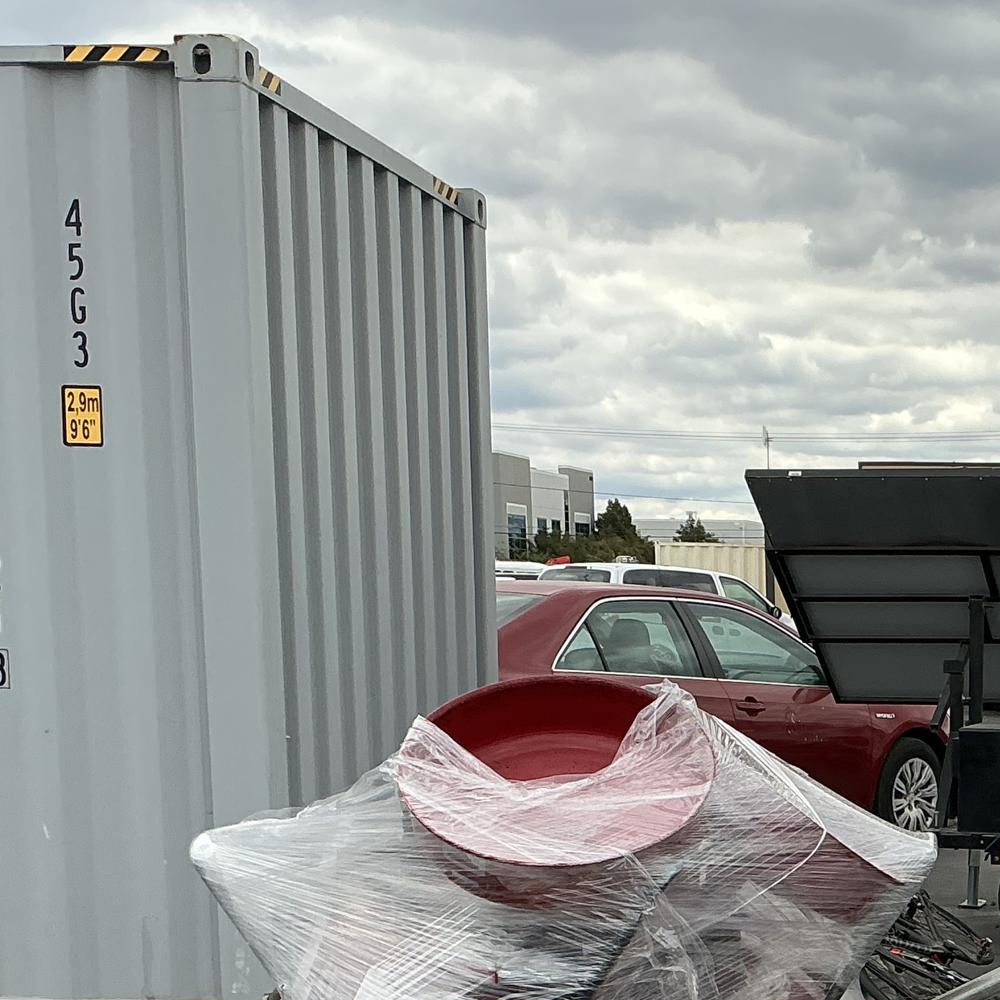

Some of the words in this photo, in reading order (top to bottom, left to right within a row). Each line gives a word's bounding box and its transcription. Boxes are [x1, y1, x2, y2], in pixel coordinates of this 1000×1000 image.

[64, 198, 89, 368] 45G3
[67, 391, 99, 416] 2,9m
[70, 418, 96, 440] 9'6"
